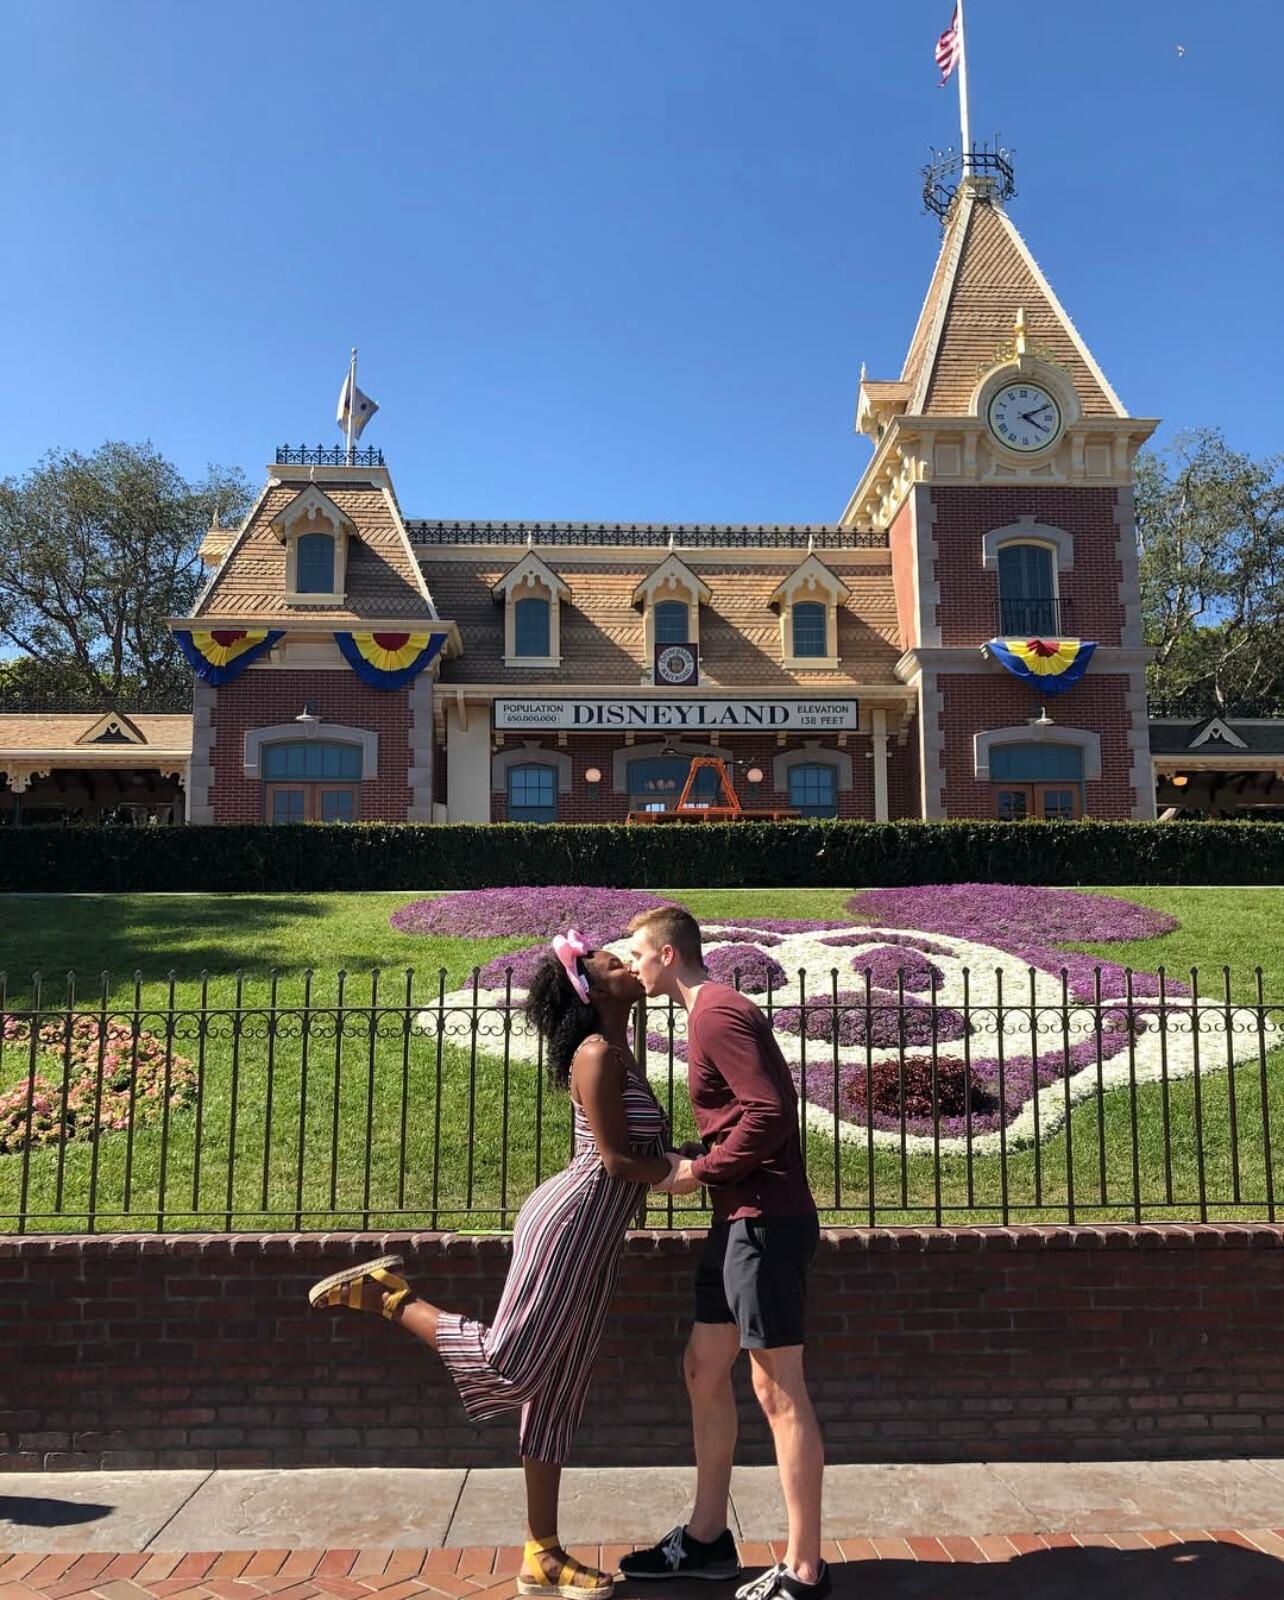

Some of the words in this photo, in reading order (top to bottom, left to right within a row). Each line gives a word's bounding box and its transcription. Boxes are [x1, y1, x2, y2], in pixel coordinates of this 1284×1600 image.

[503, 704, 563, 713] POPULATION
[798, 705, 849, 713] ELEVATION
[573, 704, 790, 725] DISNEYLAND
[801, 716, 816, 725] 138
[821, 716, 844, 725] FEET
